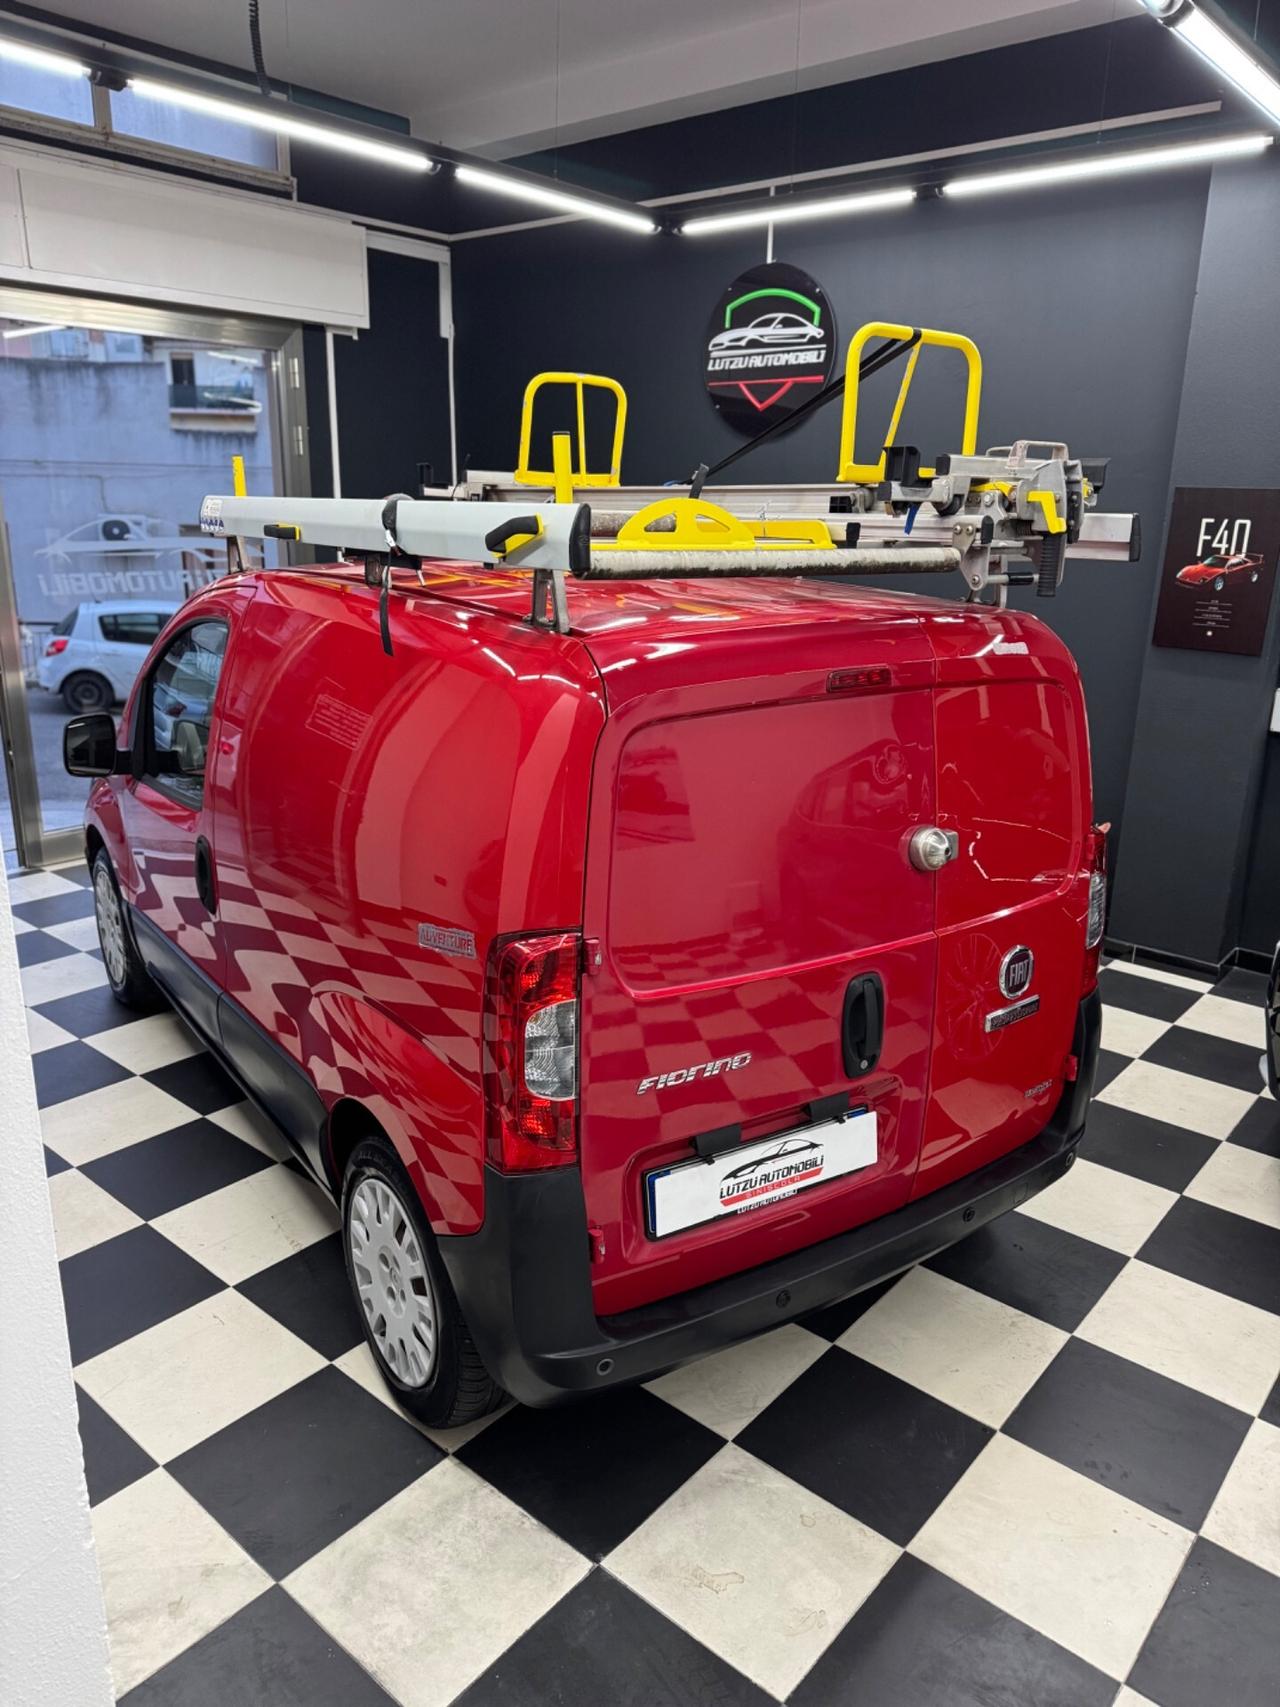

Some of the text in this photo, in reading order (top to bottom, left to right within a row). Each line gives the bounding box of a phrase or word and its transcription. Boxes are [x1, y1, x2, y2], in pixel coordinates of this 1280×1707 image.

[707, 350, 826, 371] LUTZU AUTOMOBILI
[1196, 517, 1252, 557] F40
[1009, 959, 1029, 987] FIAT
[719, 1173, 760, 1199] LUTZU
